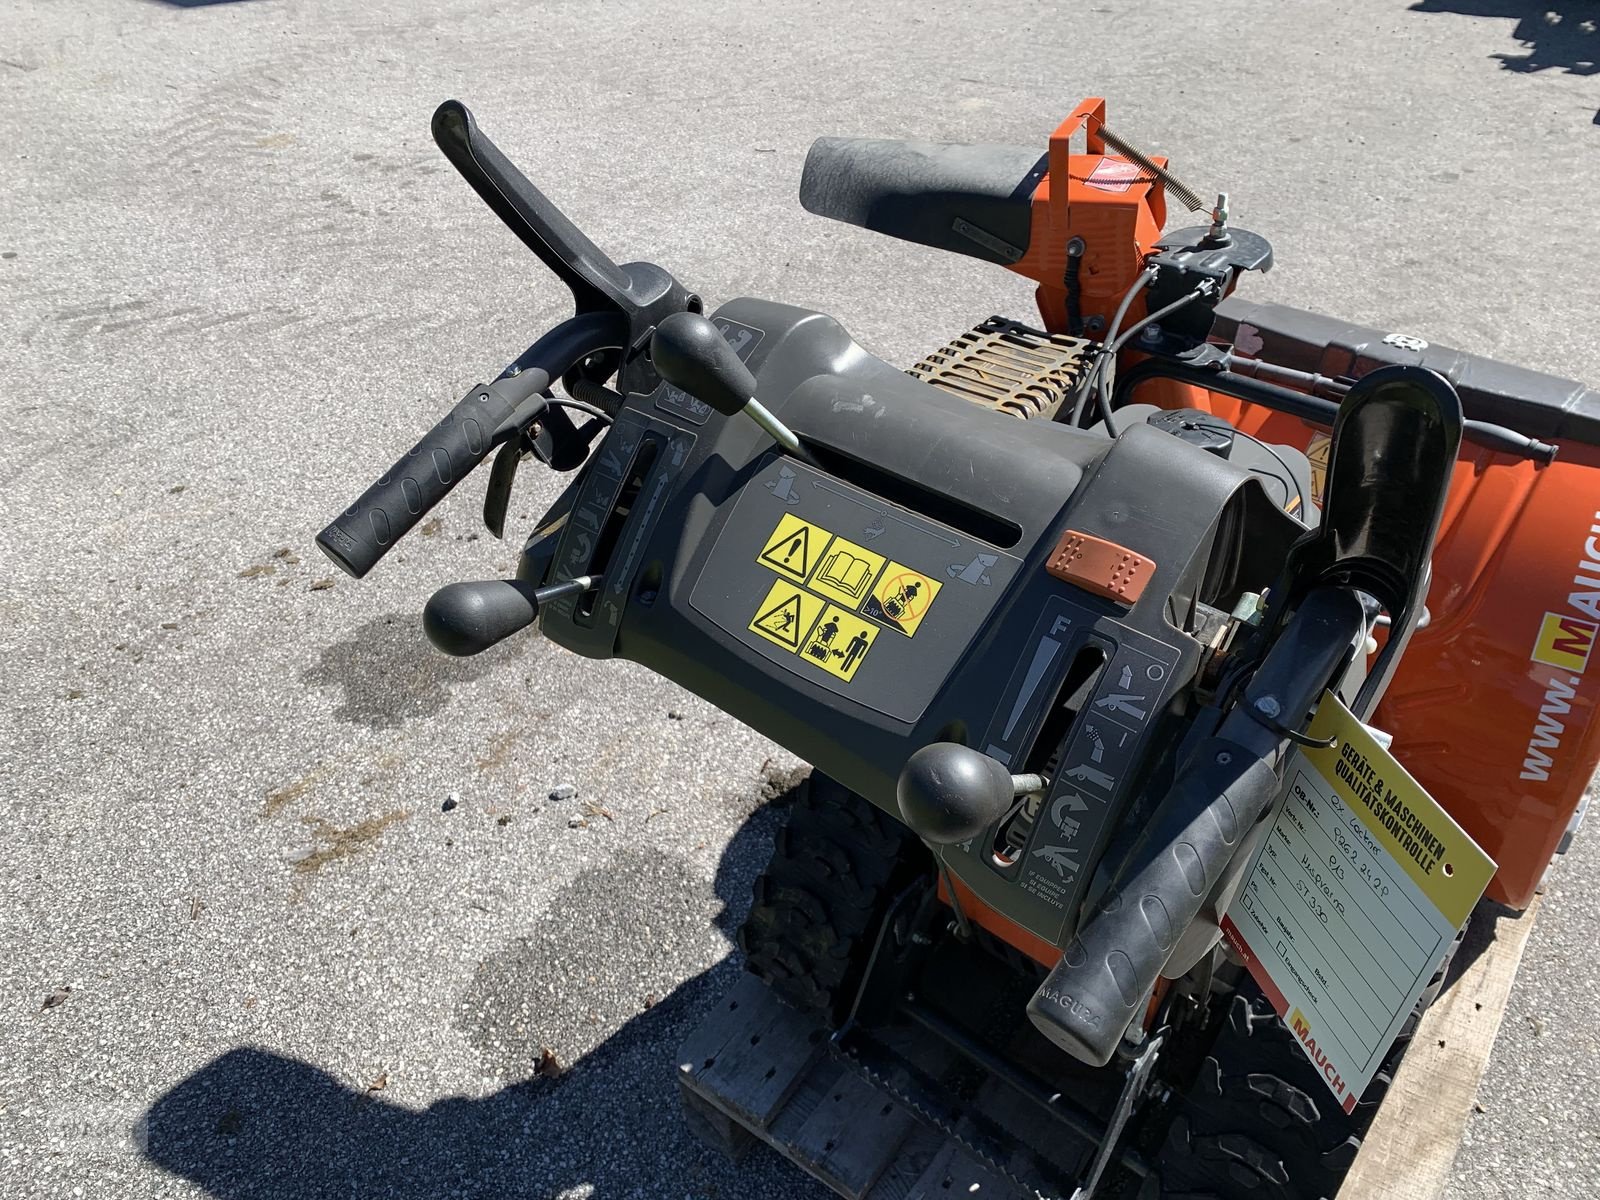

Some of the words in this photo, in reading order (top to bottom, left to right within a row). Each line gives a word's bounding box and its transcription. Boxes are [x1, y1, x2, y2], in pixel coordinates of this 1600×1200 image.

[1050, 614, 1072, 635] F
[1295, 785, 1320, 818] OB-Nr.:
[1335, 758, 1436, 876] QUALITÄTSKONTROLLE
[1341, 742, 1376, 786] GERÄTE
[1373, 777, 1384, 796] &
[1383, 789, 1446, 862] MASCHINEN
[1035, 874, 1066, 895] EQUIPPED
[1036, 883, 1060, 899] EQUIPE
[1037, 891, 1064, 909] INCLUYE
[1226, 927, 1250, 961] mauch.at
[1276, 916, 1296, 942] Baujahr:
[1284, 957, 1318, 1004] Eingangscheck
[1039, 986, 1103, 1033] MAGURA
[1293, 1017, 1346, 1095] MAUCH
